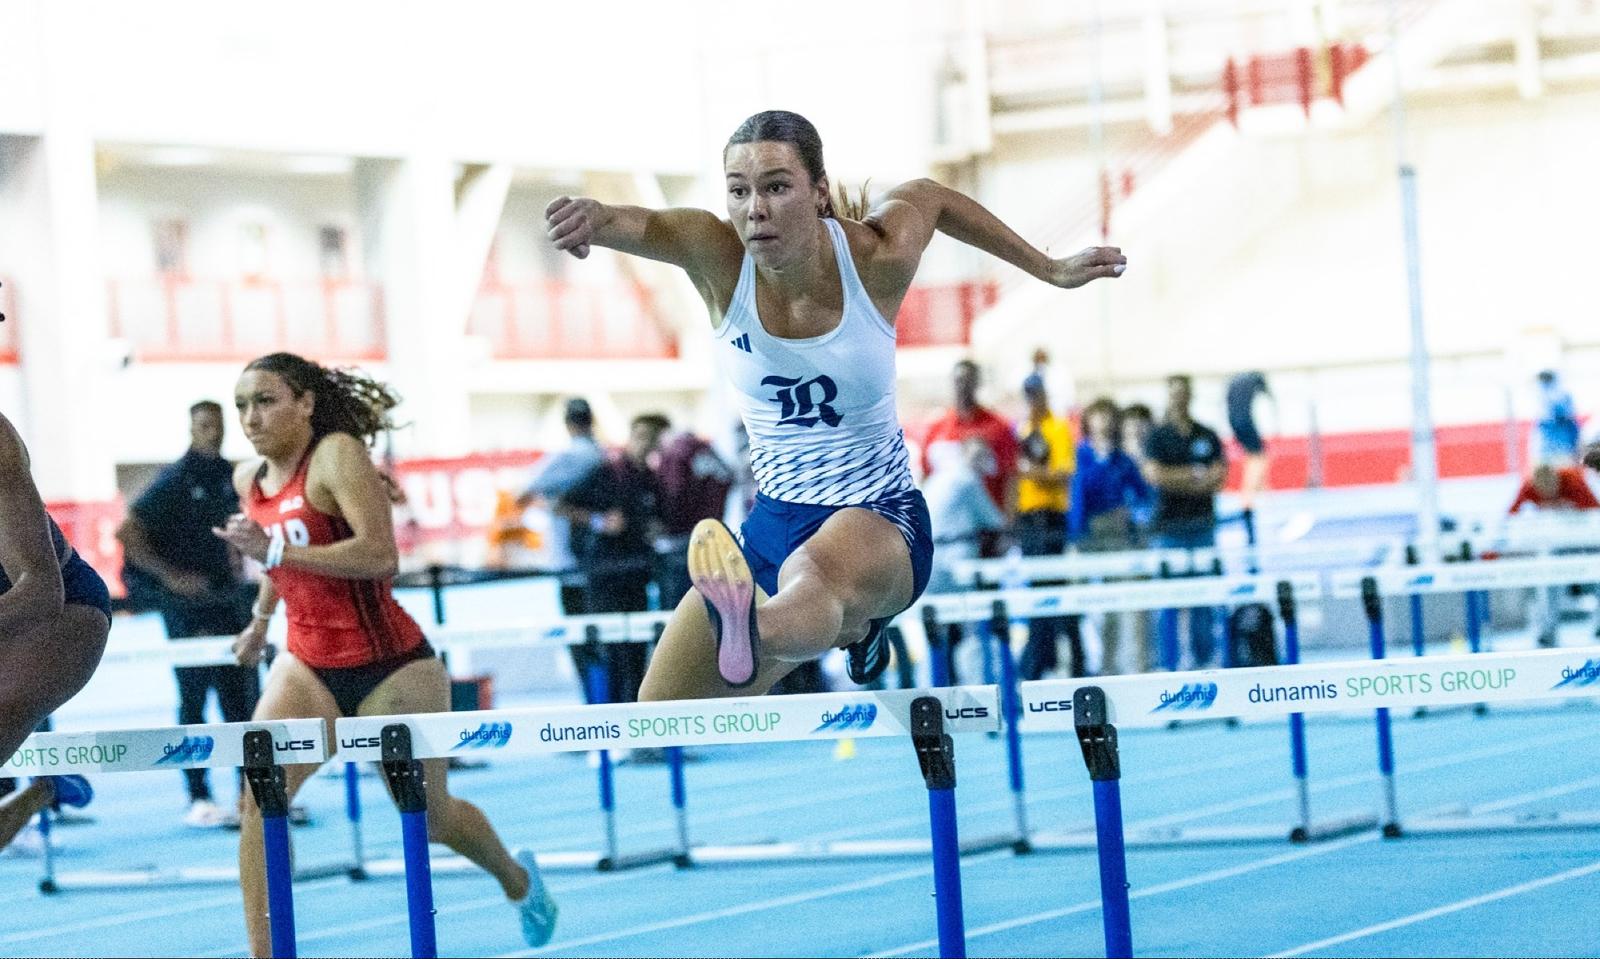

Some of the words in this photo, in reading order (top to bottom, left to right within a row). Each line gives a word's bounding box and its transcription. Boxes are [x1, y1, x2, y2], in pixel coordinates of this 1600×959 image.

[1248, 680, 1338, 703] dunamis
[1346, 672, 1433, 698] SPORTS
[1440, 668, 1517, 692] GROUP
[1159, 686, 1215, 703] dunamis
[945, 707, 989, 719] UCS
[1029, 700, 1073, 712] UCS
[821, 707, 875, 724] dunamis
[459, 726, 511, 741] dunamis
[540, 721, 621, 743] dunamis
[628, 714, 706, 738] SPORTS
[713, 711, 782, 733] GROUP
[163, 740, 214, 756] dunamis
[275, 739, 315, 751] UCS
[341, 737, 381, 749] UCS
[66, 744, 127, 765] GROUP
